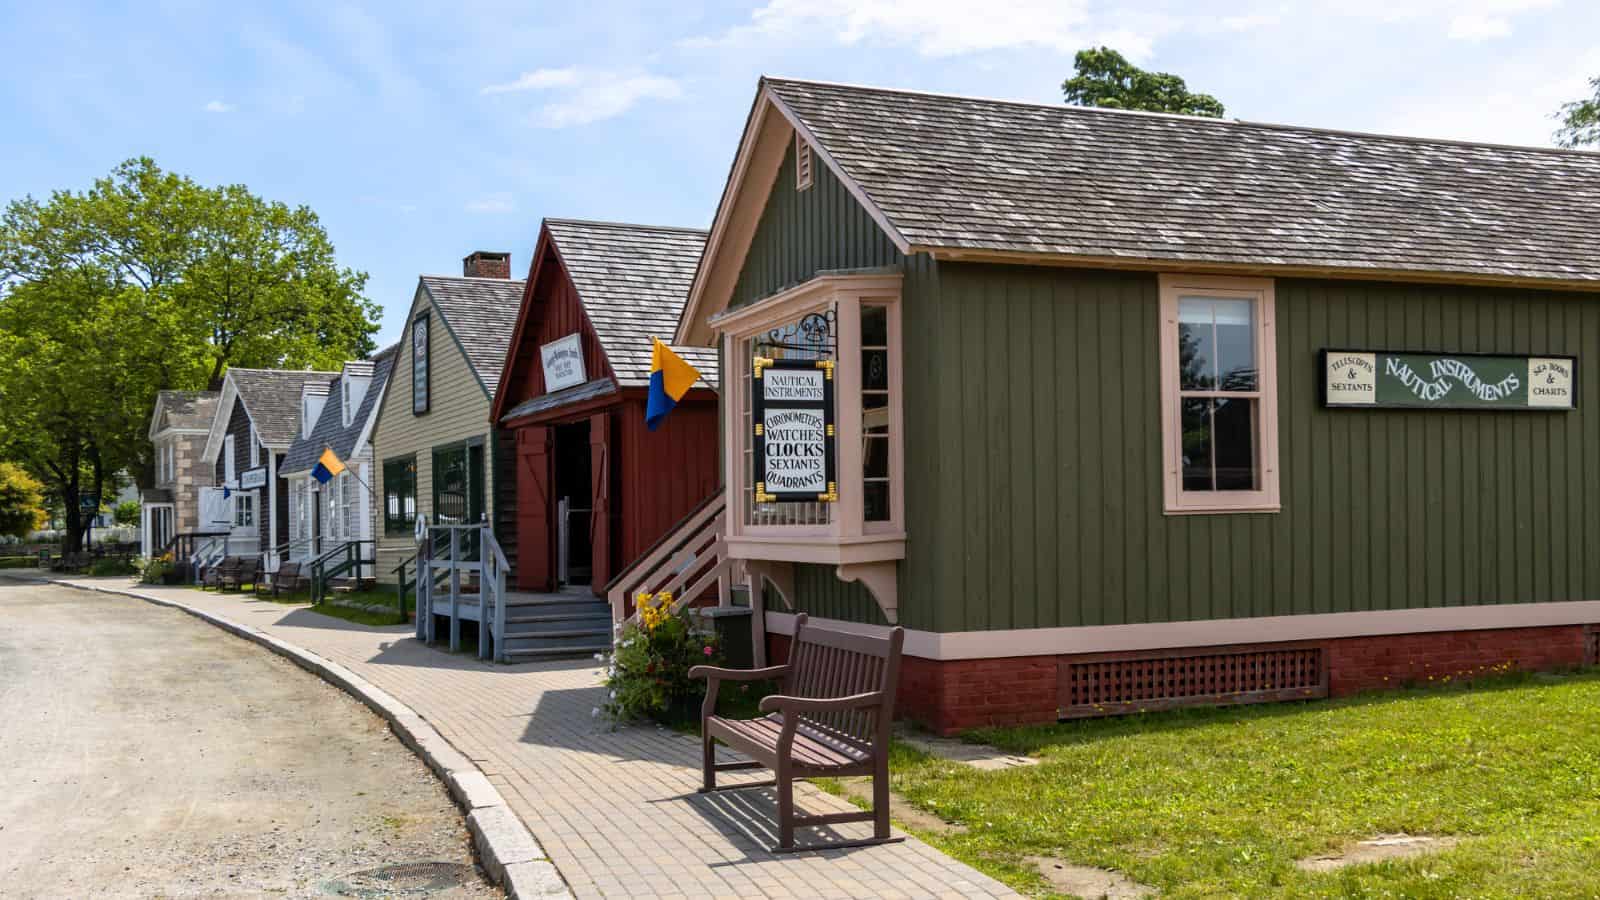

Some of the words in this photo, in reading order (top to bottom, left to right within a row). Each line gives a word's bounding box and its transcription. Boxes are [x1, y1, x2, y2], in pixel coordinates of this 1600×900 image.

[1347, 367, 1357, 379] &
[1385, 357, 1453, 400] NAUTICAL
[1429, 359, 1519, 400] INSTRUMENTS
[1546, 373, 1555, 384] &
[771, 375, 817, 387] NAUTICAL
[765, 386, 823, 398] INSTRUMENTS
[1331, 383, 1373, 392] SEXTANTS
[1533, 387, 1567, 396] CHARTS
[766, 412, 823, 429] CHRONOMETERS
[767, 429, 824, 441] WATCHES
[766, 442, 824, 457] CLOCKS
[769, 458, 821, 470] SEXTANTS
[766, 470, 824, 488] QUADRANTS
